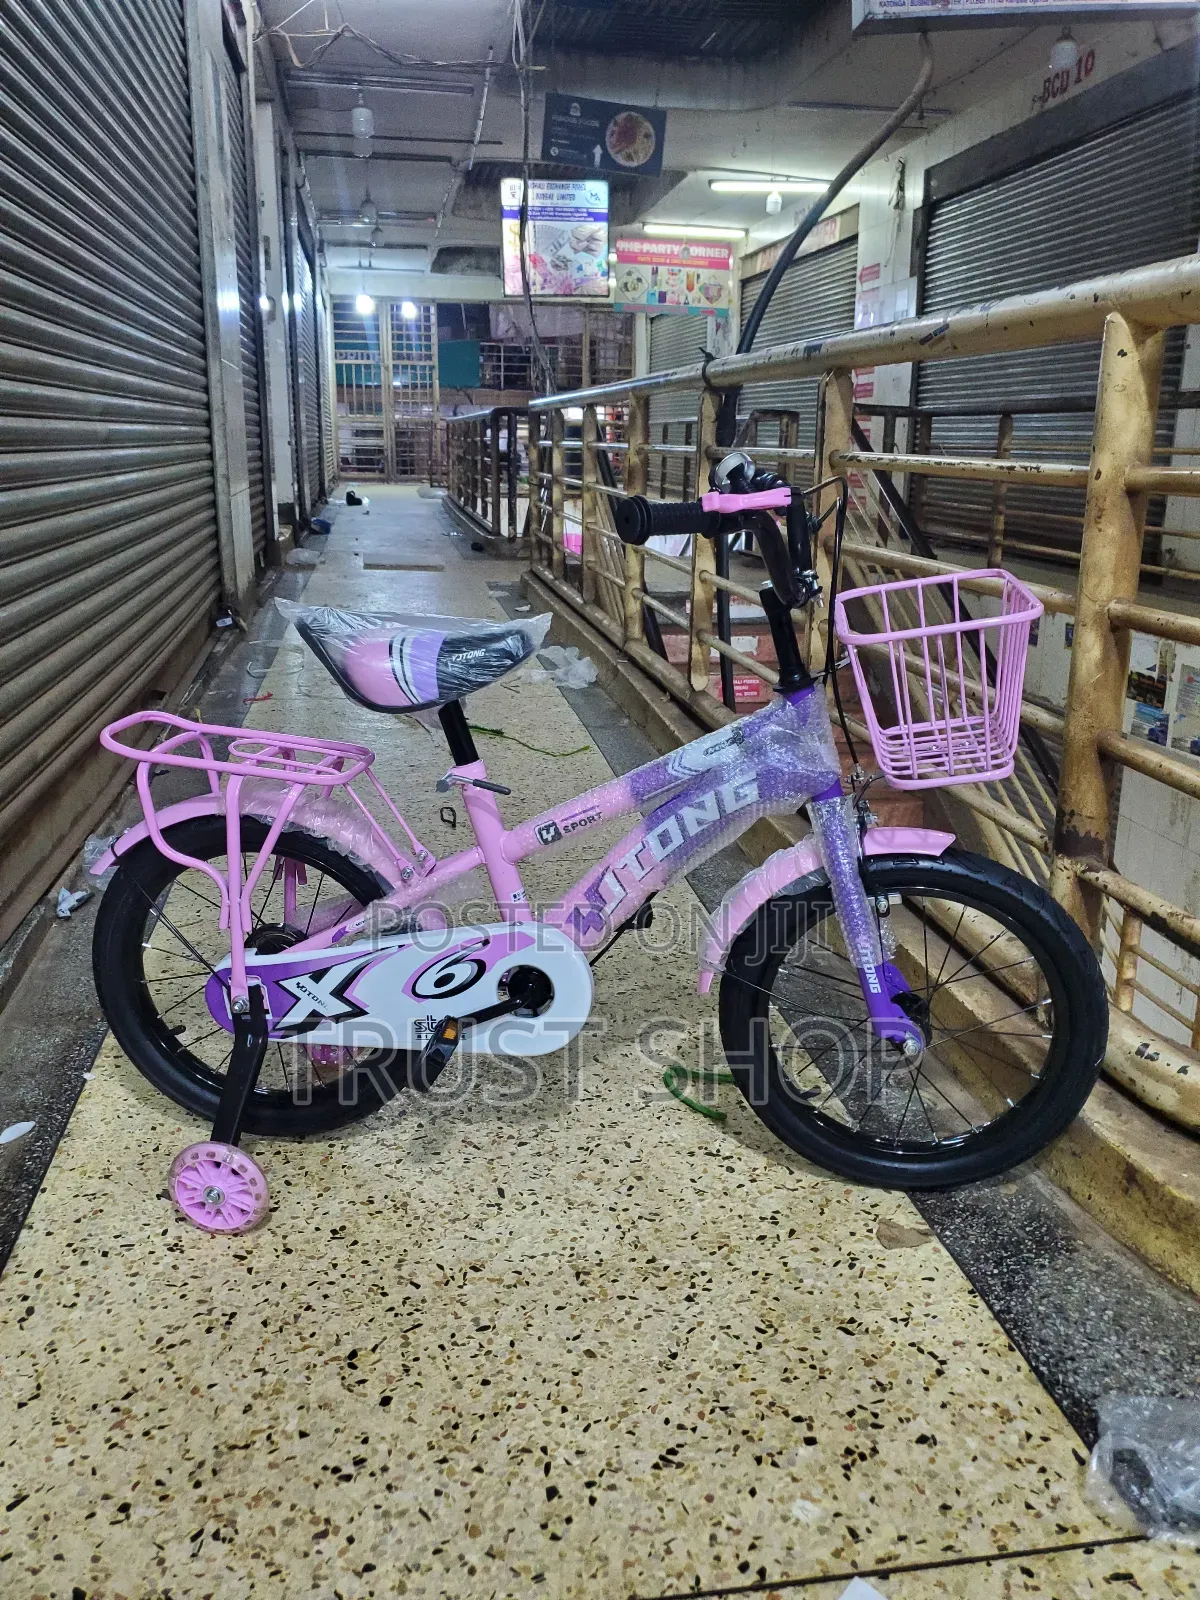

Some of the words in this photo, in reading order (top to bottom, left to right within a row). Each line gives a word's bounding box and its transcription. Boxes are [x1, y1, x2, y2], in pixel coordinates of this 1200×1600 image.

[1075, 49, 1095, 84] 10
[642, 242, 680, 255] PARTY
[681, 245, 729, 258] ORNER
[563, 811, 603, 834] SPORT
